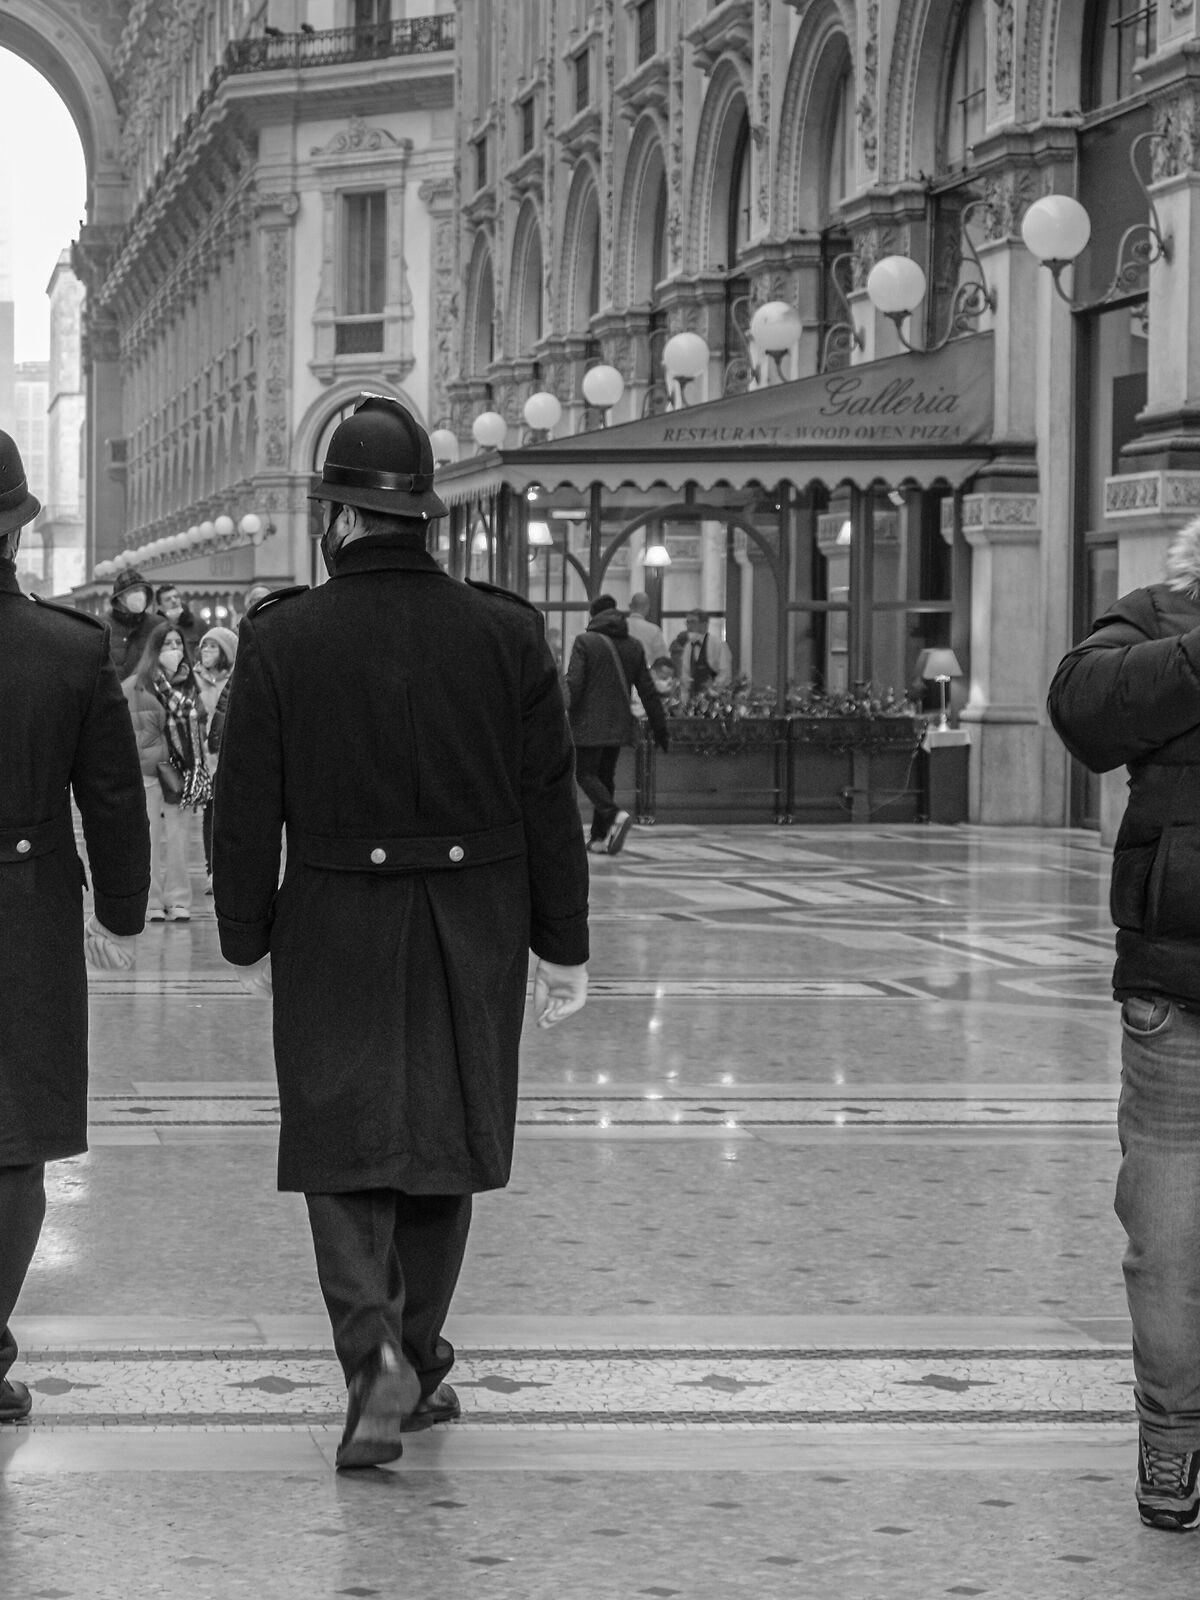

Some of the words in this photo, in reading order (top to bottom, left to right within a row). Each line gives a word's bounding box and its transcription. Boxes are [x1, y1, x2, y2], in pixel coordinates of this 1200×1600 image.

[819, 376, 961, 416] Galleria
[663, 426, 781, 441] RESTAURANT
[796, 425, 850, 440] WOOD
[854, 425, 906, 439] OVEN
[909, 424, 961, 439] PIZZA
